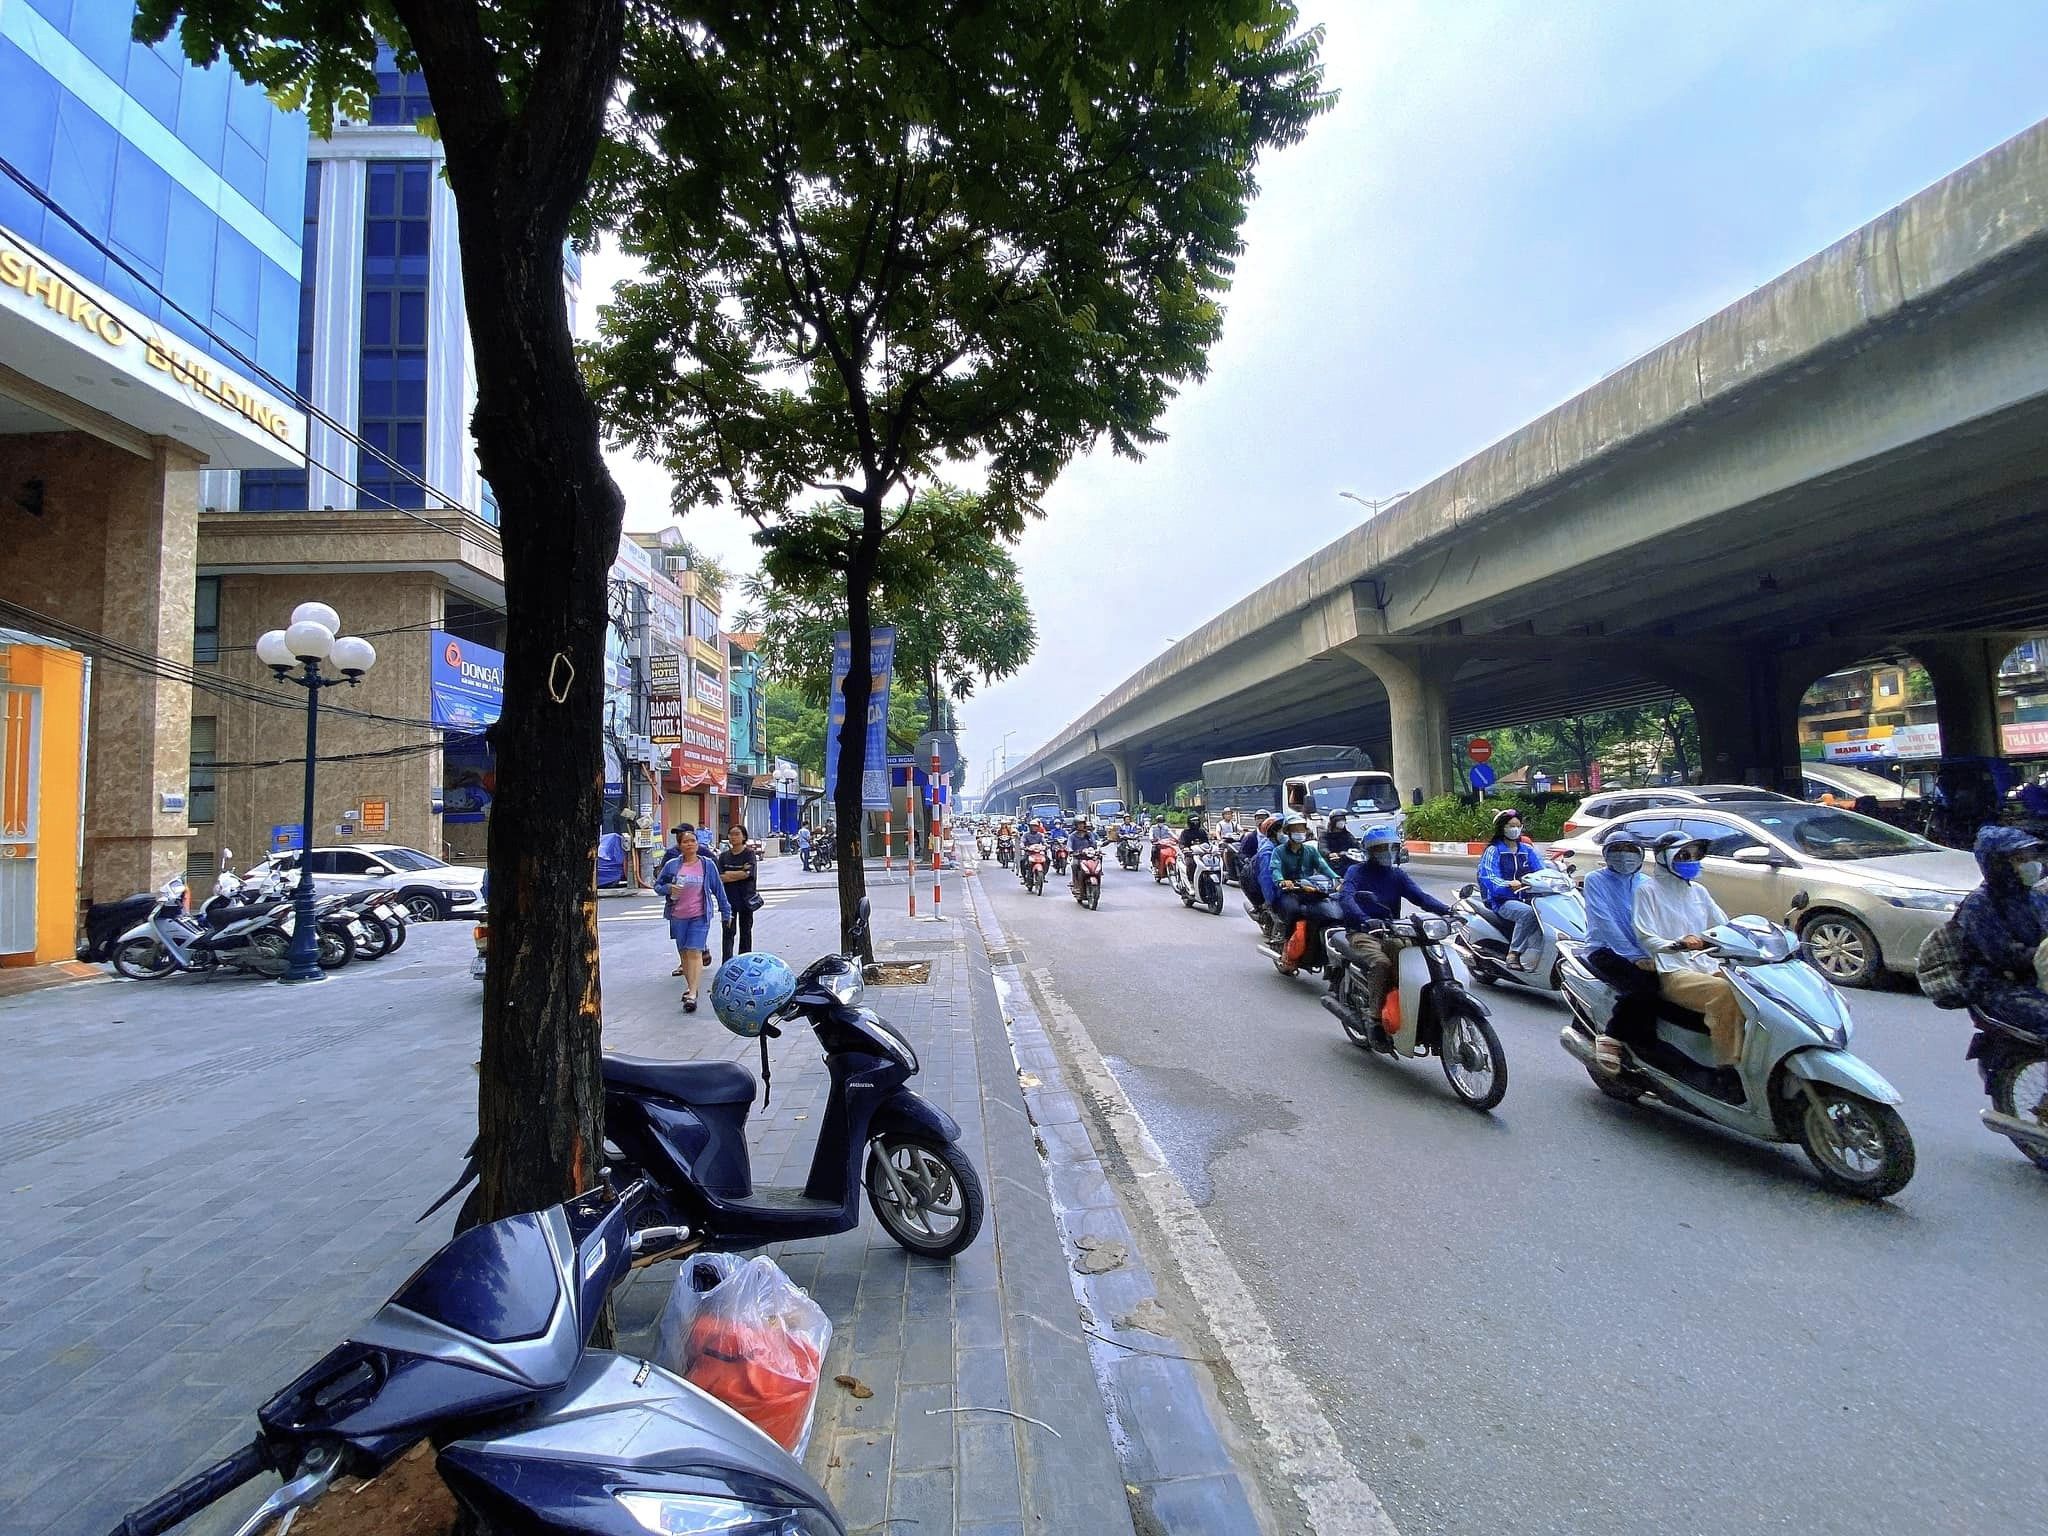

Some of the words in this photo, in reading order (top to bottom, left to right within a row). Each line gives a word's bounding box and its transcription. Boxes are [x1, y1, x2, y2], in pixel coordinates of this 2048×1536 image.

[0, 249, 128, 347] SHIKO
[145, 336, 289, 440] BUILDING
[652, 668, 678, 678] HOTEL
[651, 719, 676, 736] HOTEL
